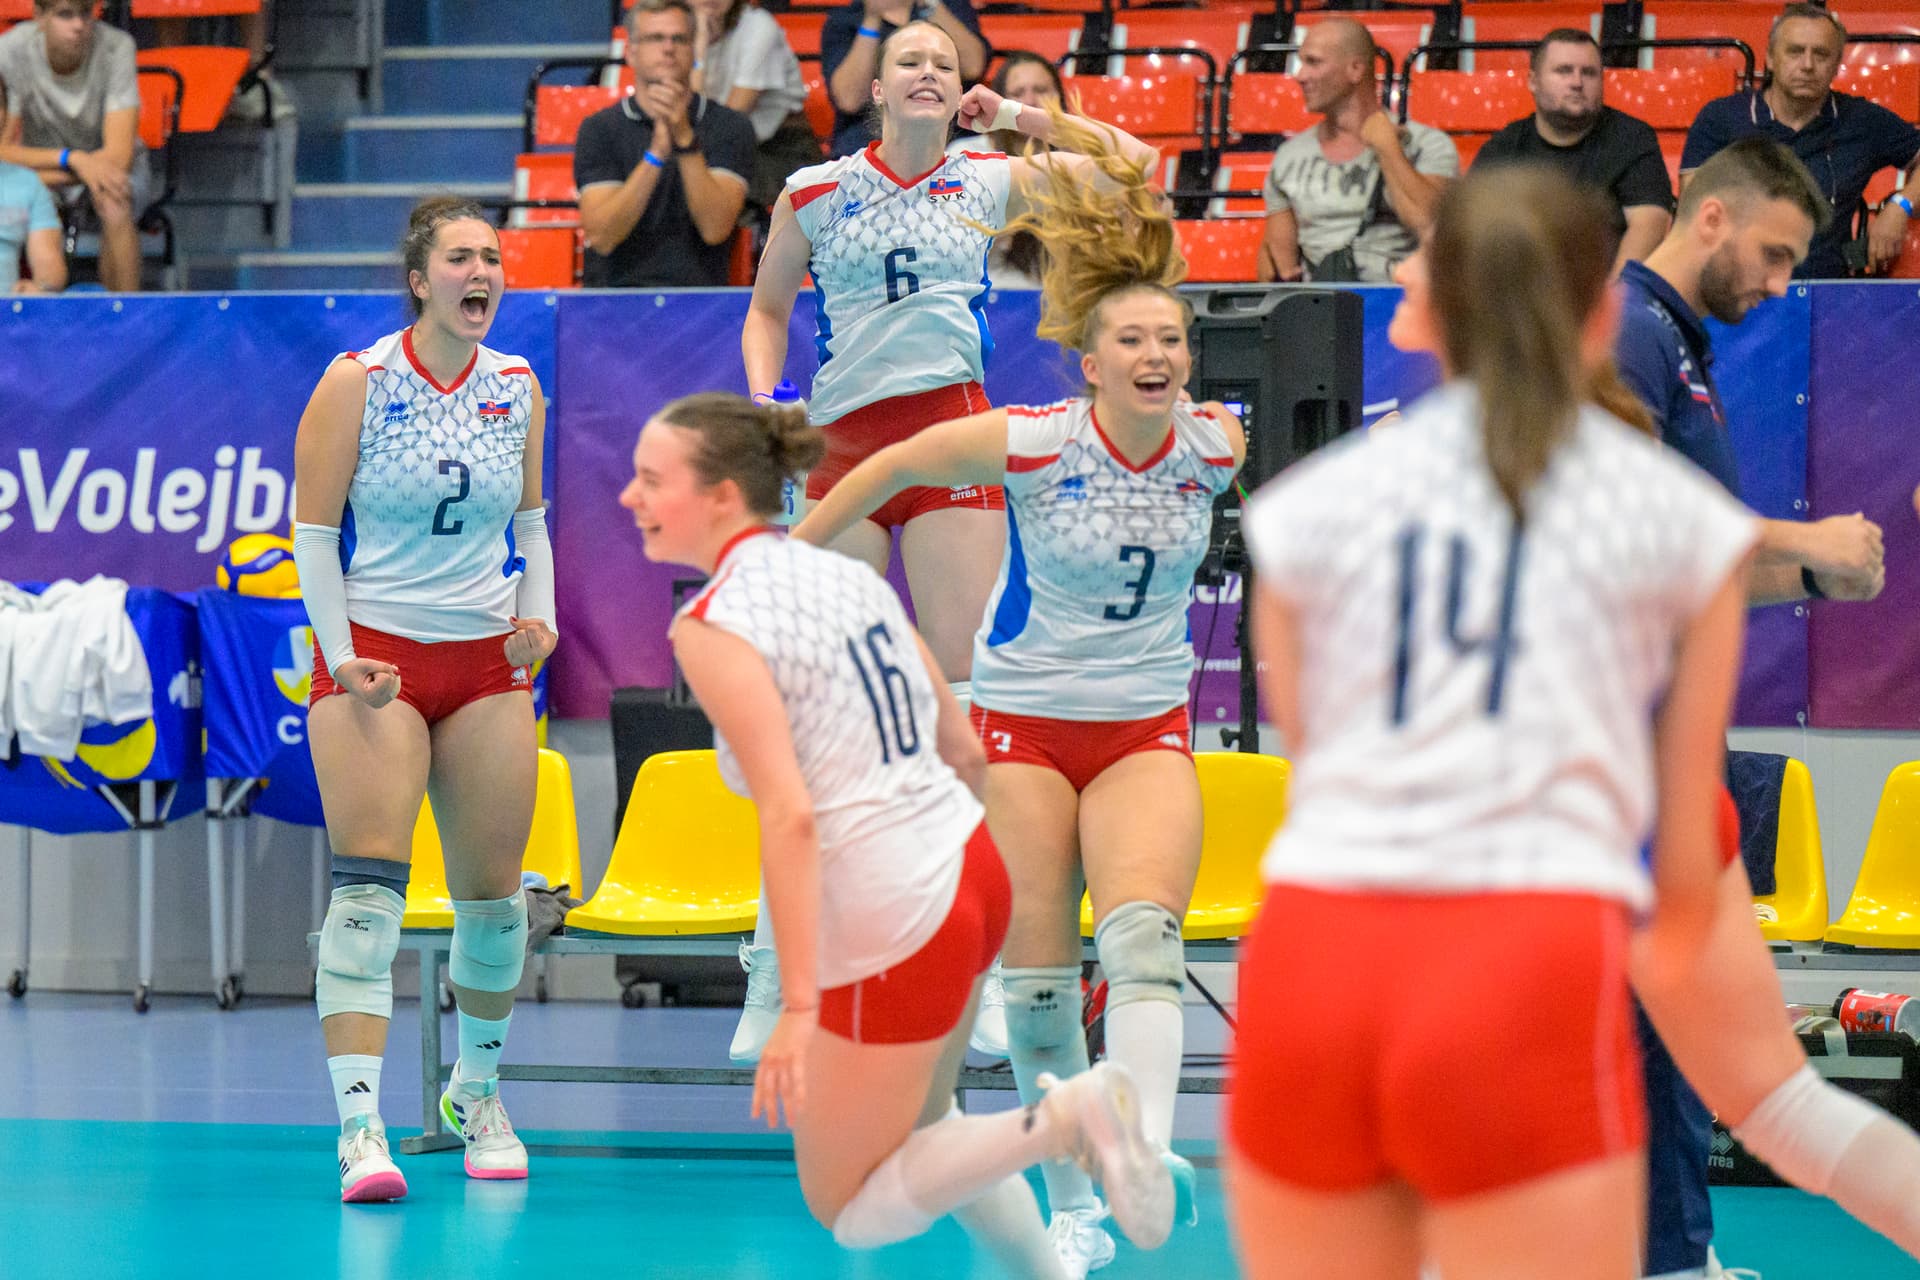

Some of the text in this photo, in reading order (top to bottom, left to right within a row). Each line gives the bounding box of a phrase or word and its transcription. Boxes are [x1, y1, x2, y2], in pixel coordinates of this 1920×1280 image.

[930, 191, 966, 204] SVK
[884, 246, 920, 304] 6
[480, 414, 512, 424] SVK
[0, 445, 297, 553] Volejb
[431, 459, 471, 536] 2
[950, 488, 978, 501] errea
[1103, 544, 1156, 622] 3
[1388, 520, 1528, 728] 14
[847, 620, 921, 765] 16
[1708, 1154, 1735, 1169] rrea
